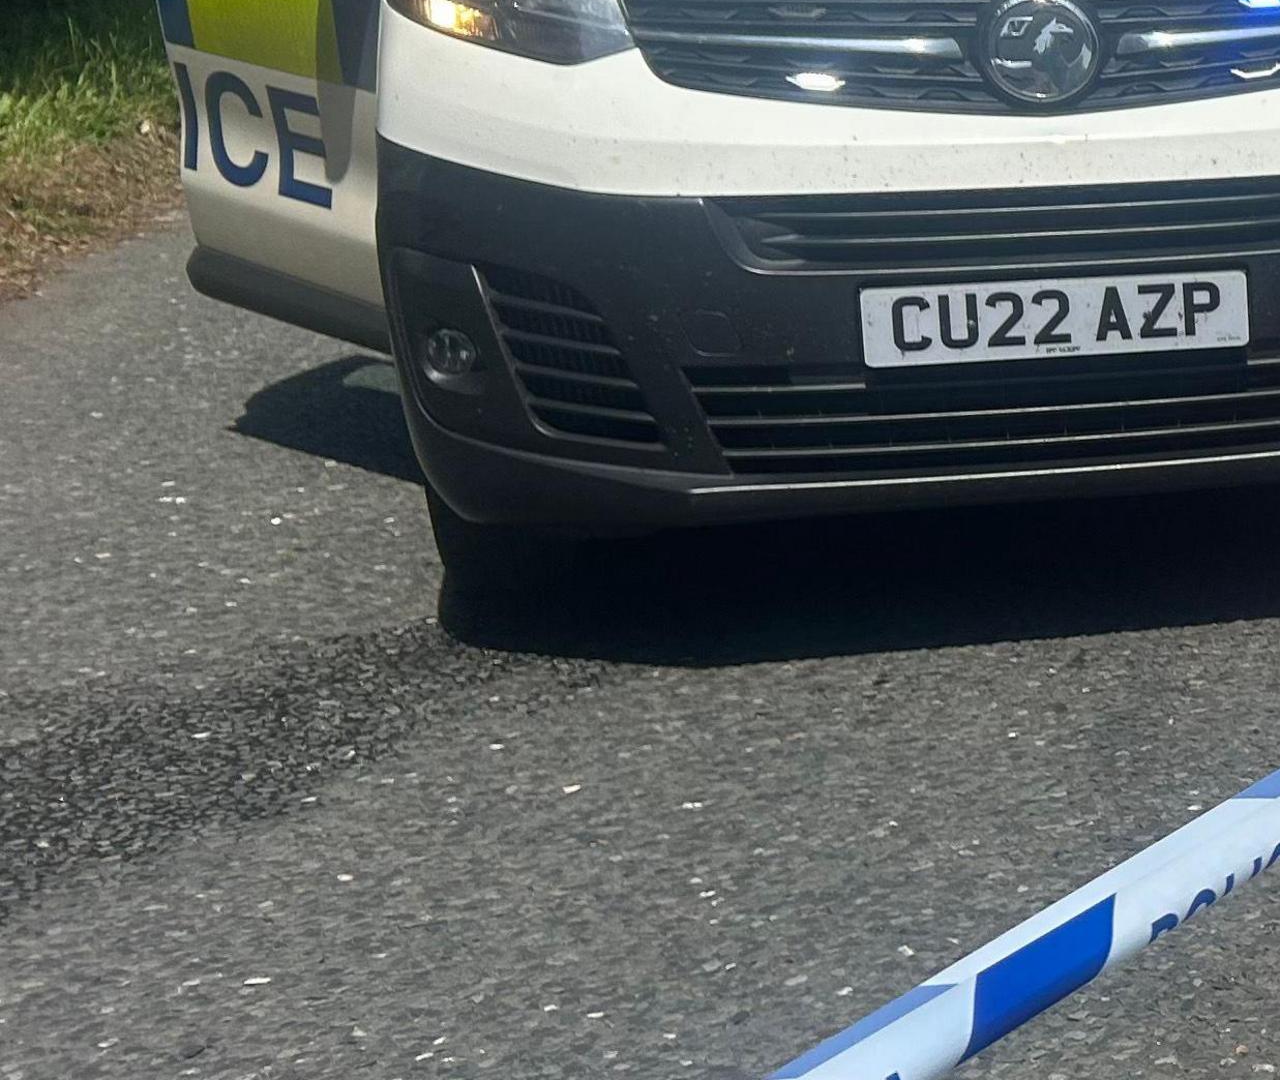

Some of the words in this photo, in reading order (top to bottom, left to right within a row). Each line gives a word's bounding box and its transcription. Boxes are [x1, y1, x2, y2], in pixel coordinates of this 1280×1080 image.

[173, 61, 333, 210] ICE
[890, 289, 1073, 352] CU22
[1095, 281, 1221, 341] AZP
